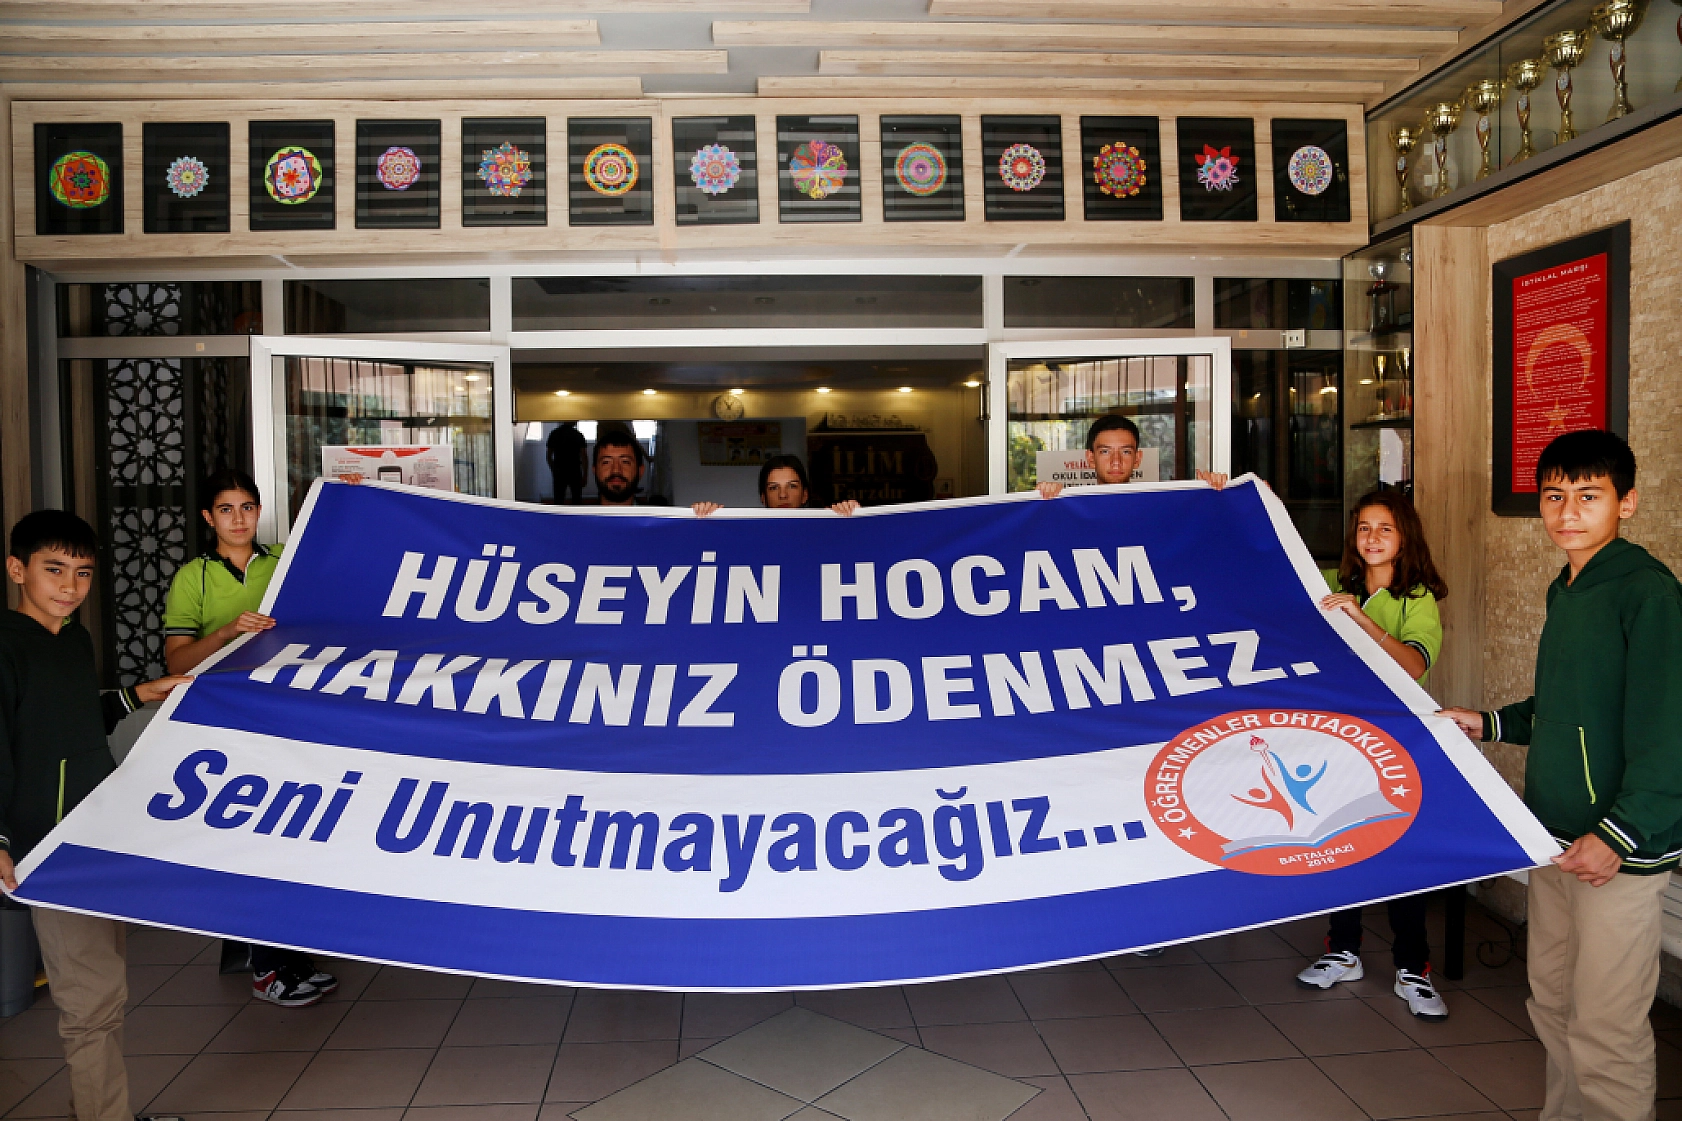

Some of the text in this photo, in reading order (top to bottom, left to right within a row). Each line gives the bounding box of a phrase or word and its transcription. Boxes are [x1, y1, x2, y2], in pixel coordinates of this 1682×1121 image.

[832, 445, 905, 475] İLİM
[1052, 471, 1079, 481] OKUL
[382, 543, 1197, 624] HÜSEYİN HOCAM,
[247, 628, 1320, 728] HAKKINIZ ÖDENMEZ.
[1150, 711, 1407, 823] ÖĞRETMENLER ORTAOKULU
[147, 749, 1147, 893] Seni Unutmayacağız...
